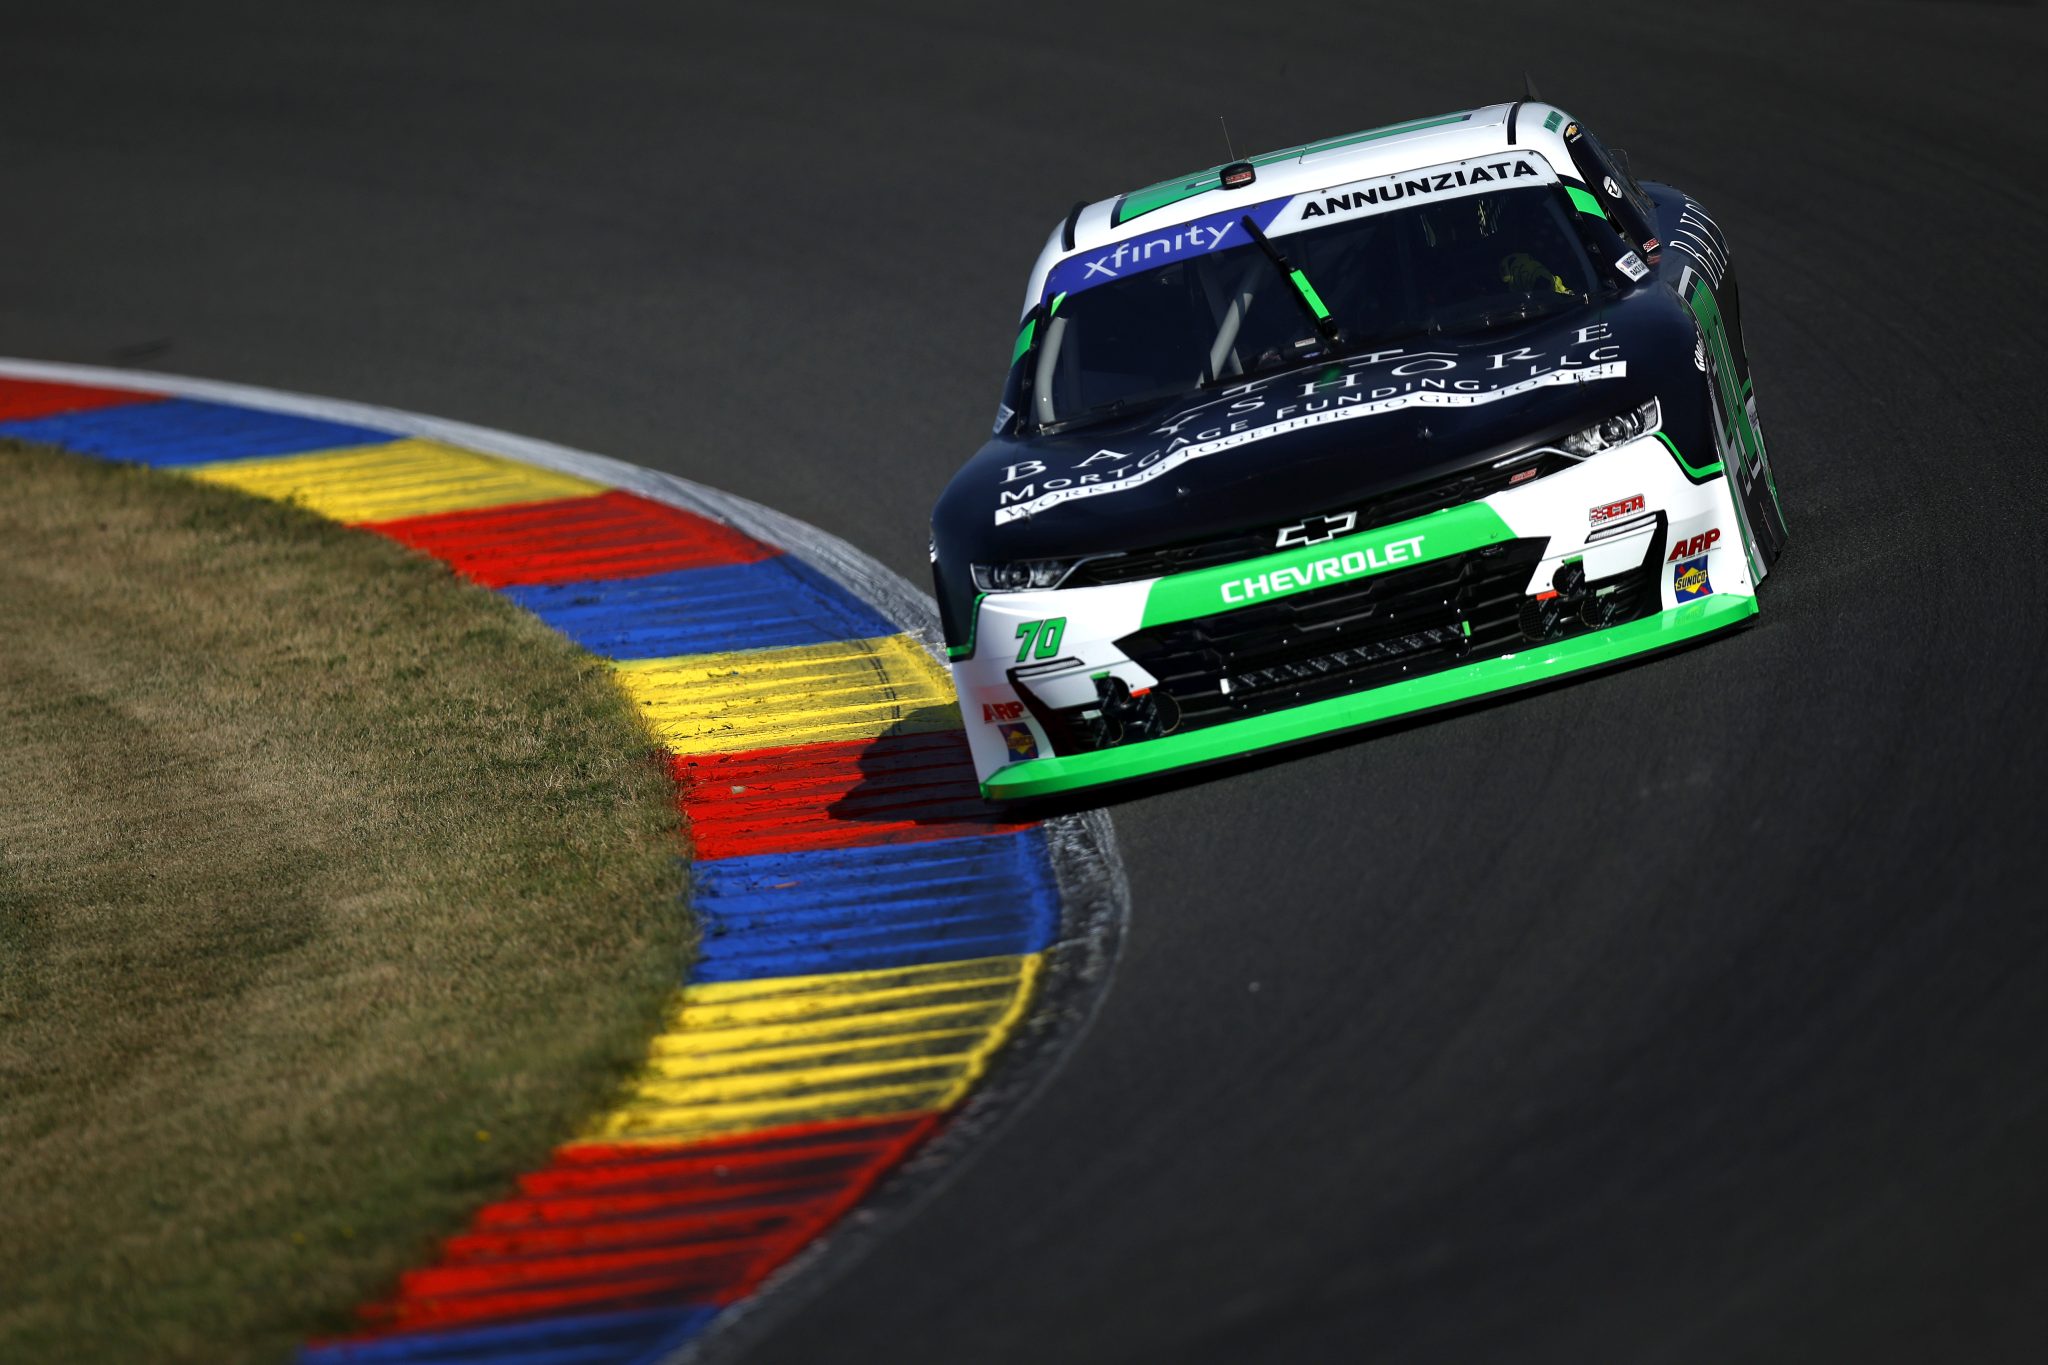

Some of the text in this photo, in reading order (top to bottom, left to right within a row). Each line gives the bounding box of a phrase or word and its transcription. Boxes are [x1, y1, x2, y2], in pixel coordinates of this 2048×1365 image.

[1301, 160, 1538, 220] ANNUNZIATA
[1083, 221, 1235, 280] xfinity
[1000, 419, 1249, 504] MORTGAGE
[1530, 345, 1620, 376] LLC
[1006, 461, 1167, 517] WORKING
[1177, 410, 1350, 457] TOGETHER
[1363, 398, 1408, 413] TO
[1420, 394, 1482, 404] GET
[1220, 535, 1425, 604] CHEVROLET
[1667, 528, 1721, 562] ARP
[1676, 571, 1707, 590] SUNOCO
[1015, 616, 1067, 663] 70
[982, 701, 1025, 722] ARP
